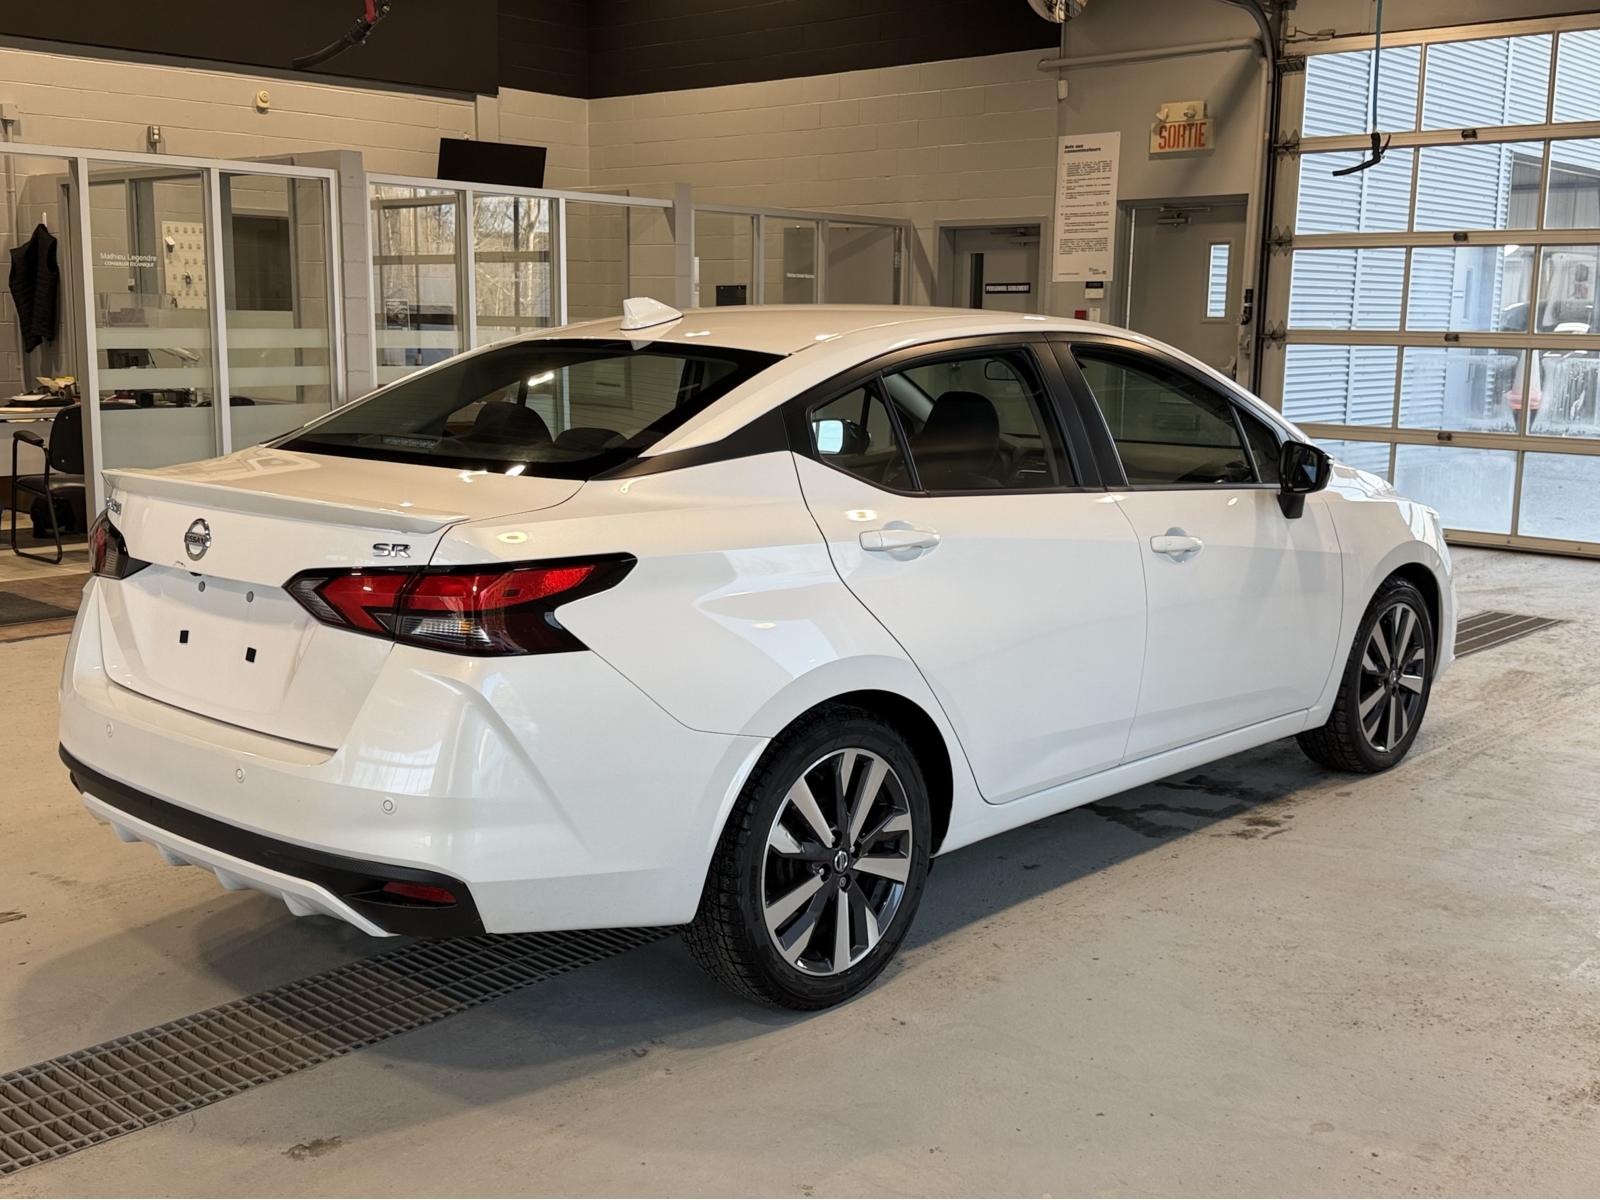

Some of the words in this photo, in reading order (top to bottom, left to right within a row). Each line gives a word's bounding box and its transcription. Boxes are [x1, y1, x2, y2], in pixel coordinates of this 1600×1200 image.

[1158, 122, 1207, 149] SORTIE
[100, 252, 126, 260] Mathieu
[128, 254, 157, 263] Legendre
[372, 543, 411, 558] SR
